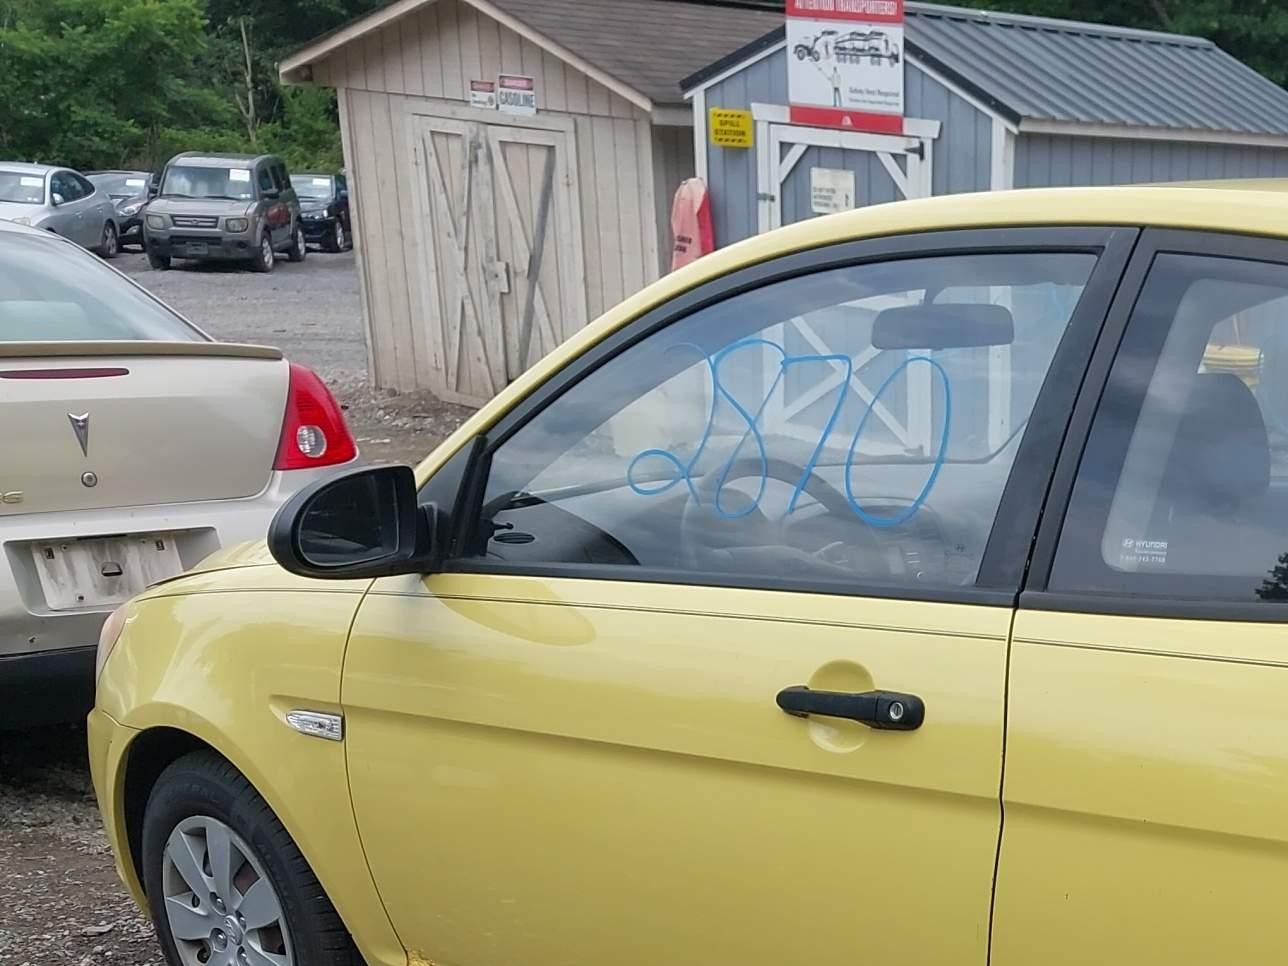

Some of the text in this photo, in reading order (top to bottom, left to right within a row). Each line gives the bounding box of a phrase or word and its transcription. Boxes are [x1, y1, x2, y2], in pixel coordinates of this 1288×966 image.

[500, 90, 534, 108] GASOLINE
[714, 128, 746, 137] STATION
[627, 338, 951, 527] 2870
